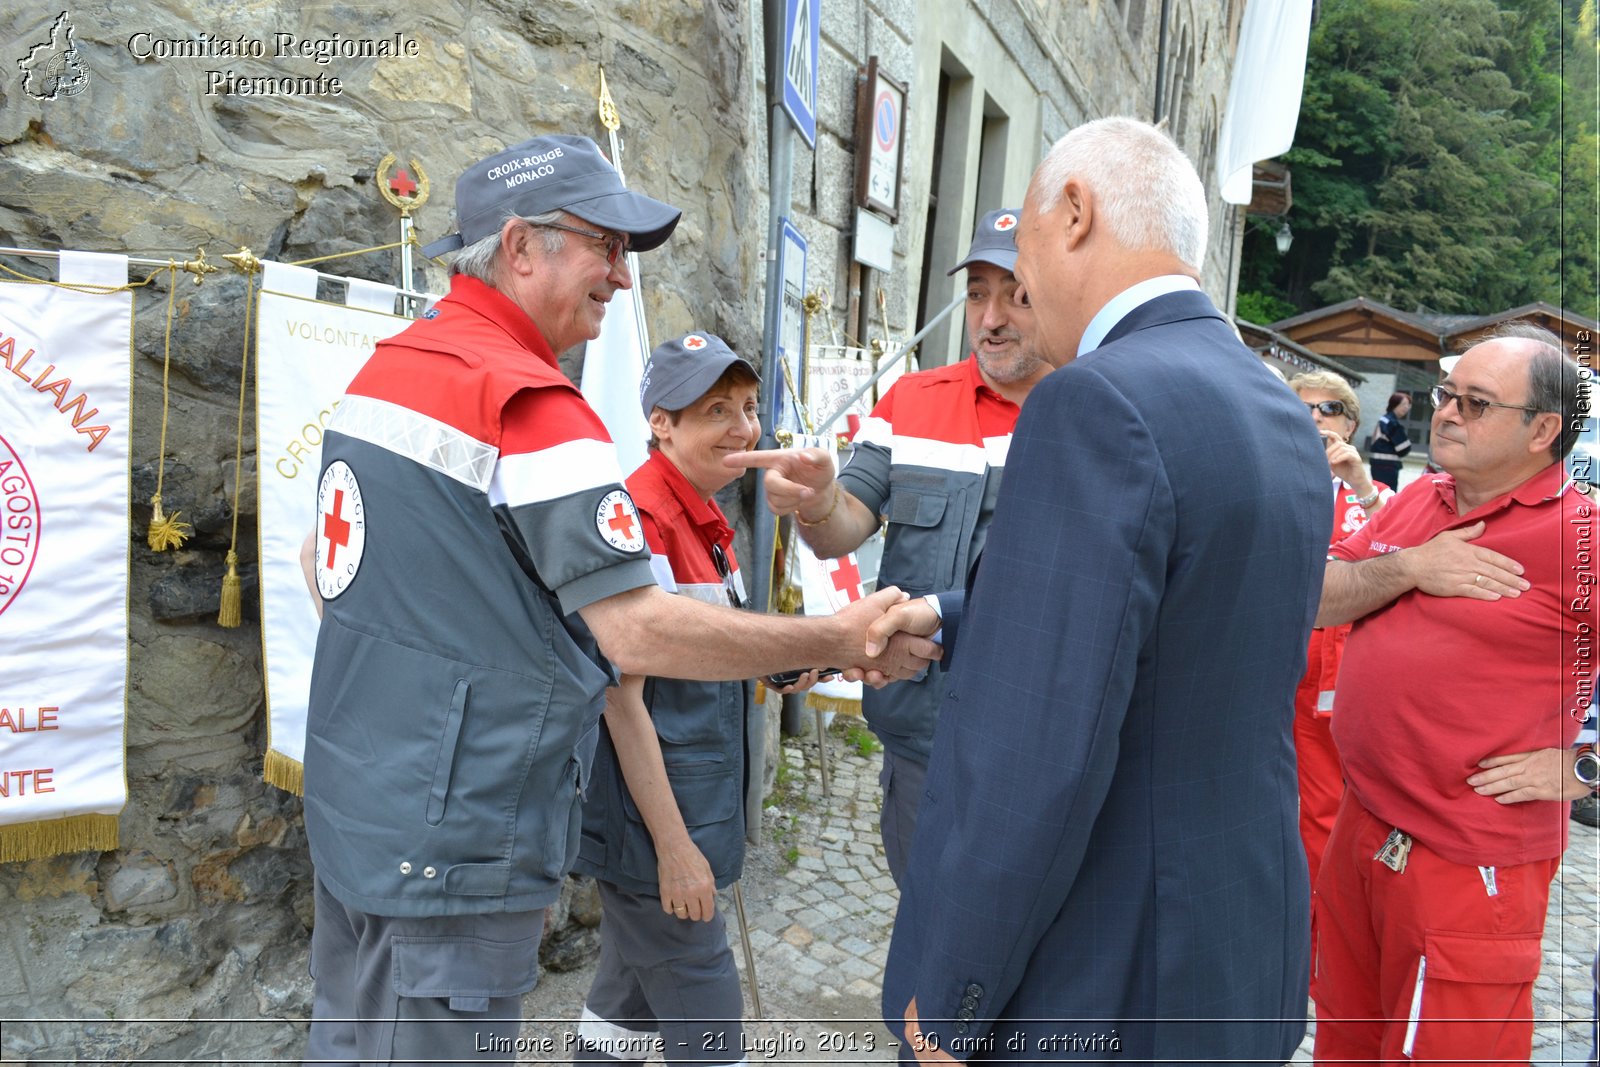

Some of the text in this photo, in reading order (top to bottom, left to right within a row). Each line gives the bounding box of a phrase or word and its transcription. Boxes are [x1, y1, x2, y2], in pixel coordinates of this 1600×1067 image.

[487, 147, 564, 180] CROIX-ROUGE
[505, 164, 555, 188] MONACO
[0, 331, 111, 453] ALIANA
[343, 468, 363, 531] ROUGE
[597, 495, 612, 525] CROIX
[0, 706, 60, 733] ALE
[0, 767, 56, 797] NTE
